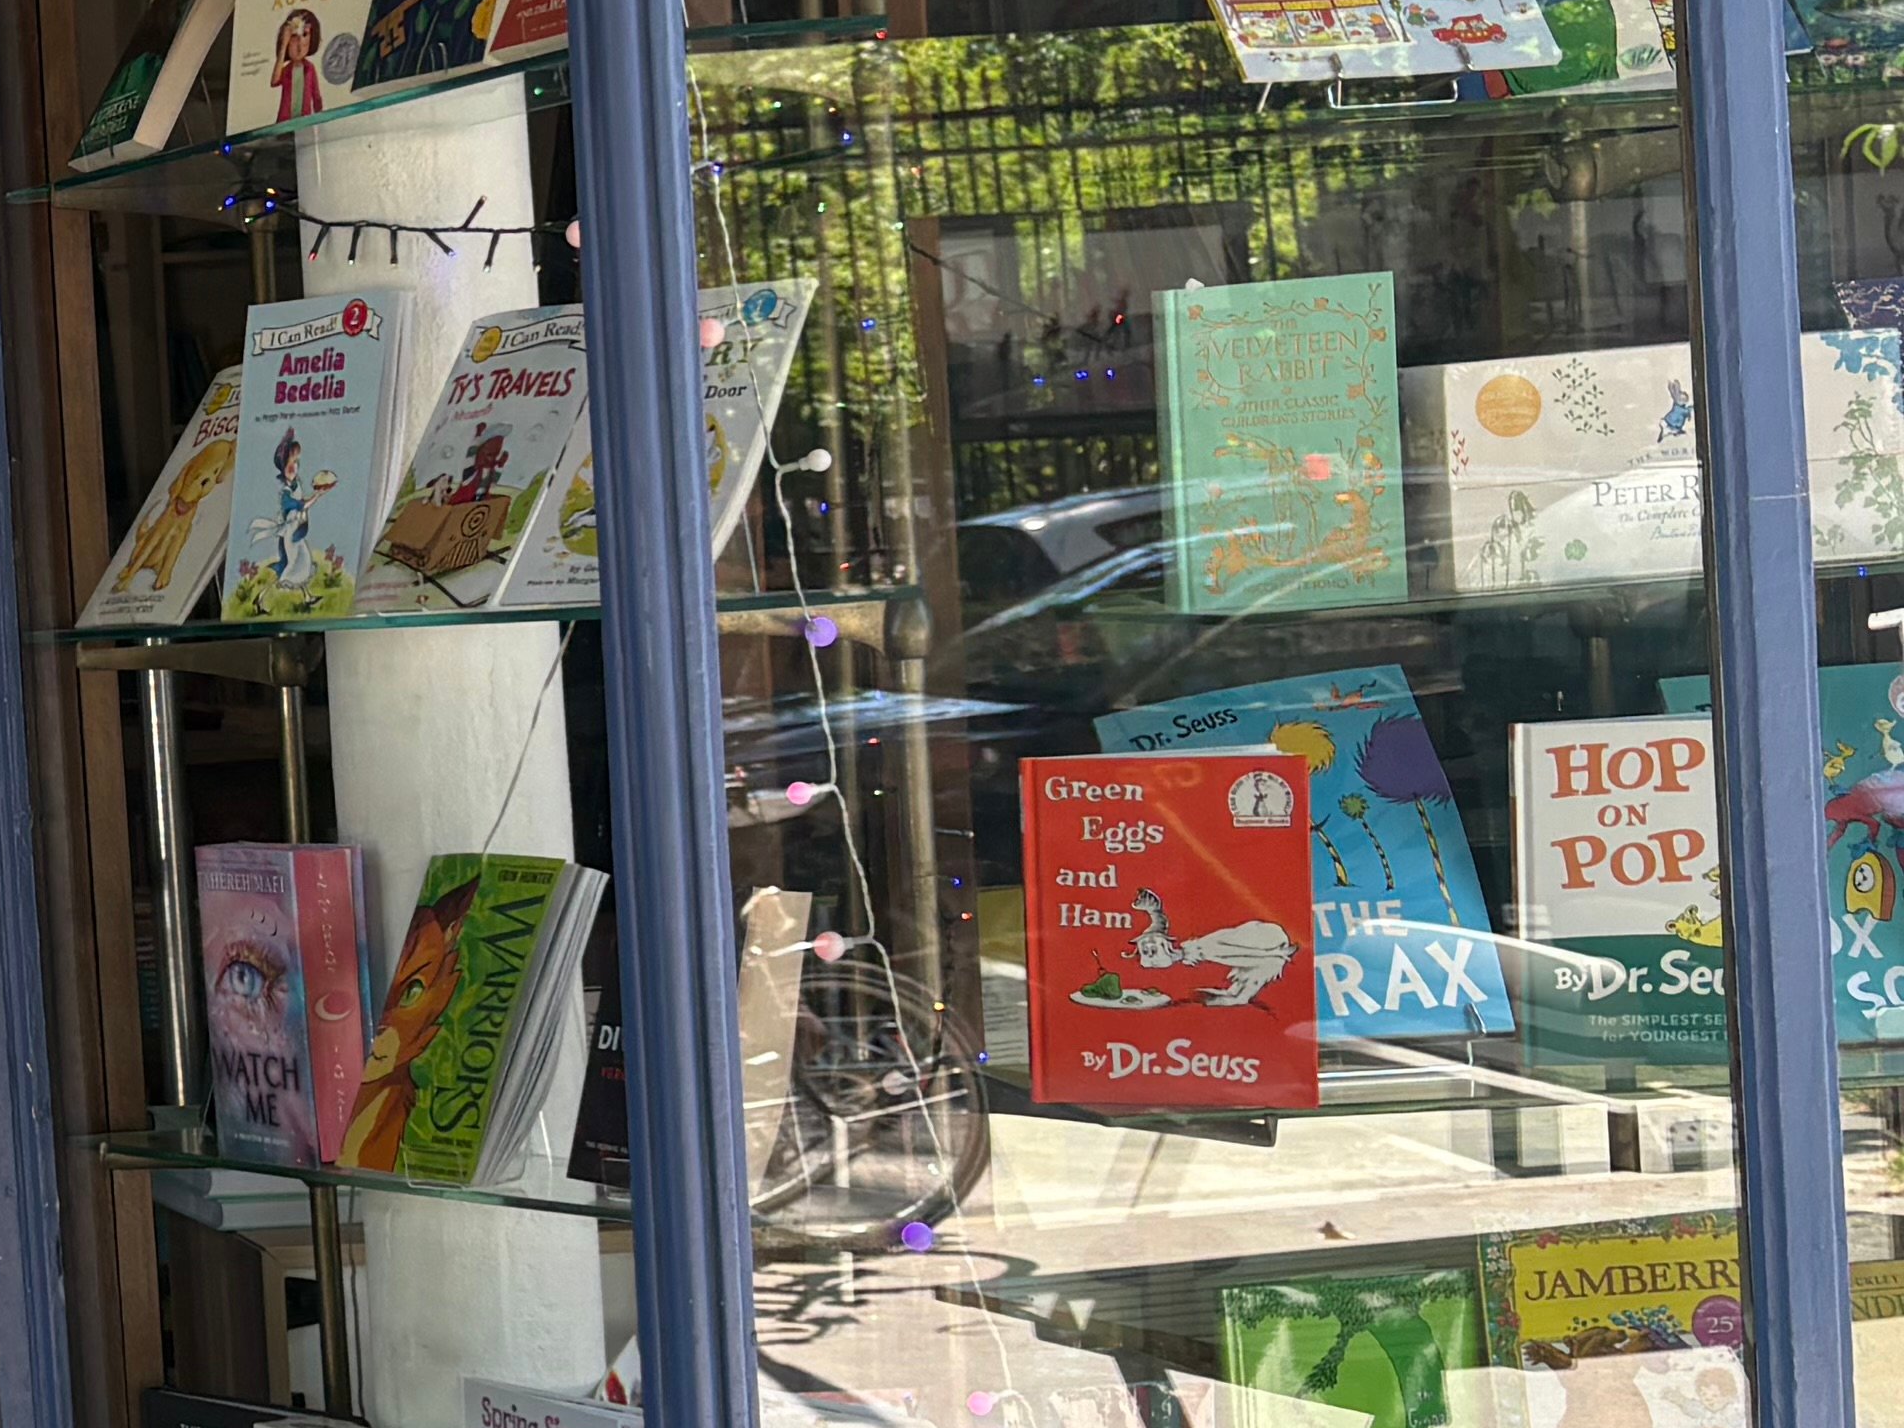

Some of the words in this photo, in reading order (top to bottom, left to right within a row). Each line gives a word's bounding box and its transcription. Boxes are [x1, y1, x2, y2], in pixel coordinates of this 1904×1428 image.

[278, 327, 302, 346] Can
[303, 317, 339, 341] Read!
[349, 308, 361, 325] 2
[510, 325, 541, 348] Can
[1208, 328, 1359, 361] VELVETEEN
[278, 347, 345, 378] Amelia
[1239, 354, 1336, 384] RABBIT
[274, 374, 346, 405] Bedelia
[491, 368, 576, 400] TRAVELS
[704, 385, 748, 400] Door
[1129, 731, 1173, 753] Dr.
[1172, 707, 1239, 740] Seuss
[1545, 737, 1707, 799] HOP
[1044, 775, 1144, 803] Green
[1597, 802, 1650, 828] ON
[1081, 815, 1166, 854] Eggs
[1550, 828, 1706, 890] POP
[1055, 864, 1119, 889] and
[1058, 903, 1134, 930] Ham
[1312, 898, 1403, 940] THE
[1313, 938, 1489, 1018] RAX
[1554, 967, 1588, 992] By
[1587, 955, 1653, 1001] Dr.
[429, 894, 547, 1134] WARRIORS
[1622, 1013, 1700, 1027] SIMPLEST
[1628, 1029, 1718, 1042] YOUNGEST
[212, 1045, 301, 1093] WATCH
[1080, 1050, 1108, 1072] By
[1106, 1040, 1159, 1080] Dr.
[1164, 1037, 1260, 1084] Seuss
[245, 1093, 281, 1128] ME
[1707, 1314, 1733, 1334] 25
